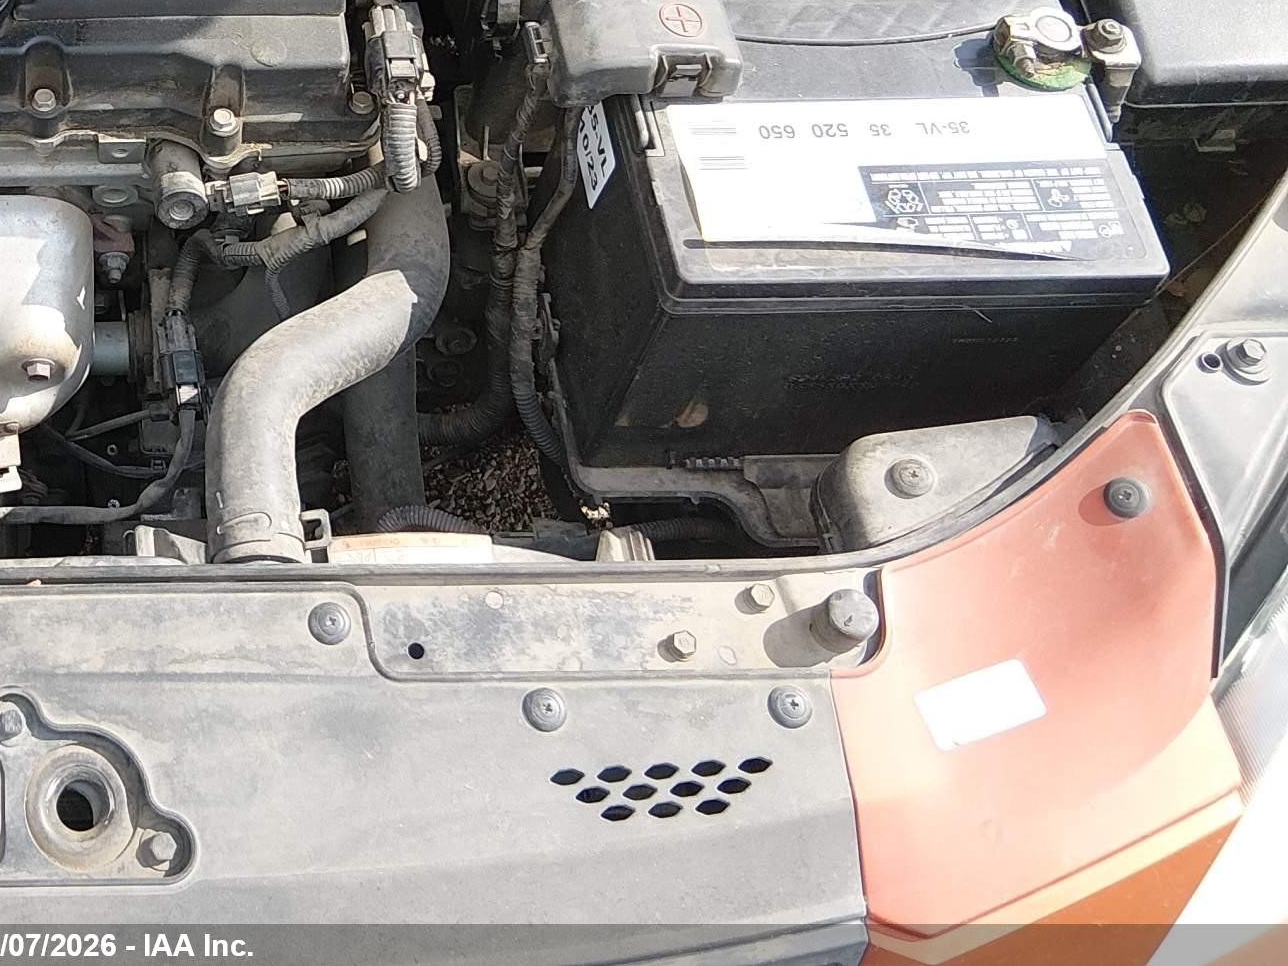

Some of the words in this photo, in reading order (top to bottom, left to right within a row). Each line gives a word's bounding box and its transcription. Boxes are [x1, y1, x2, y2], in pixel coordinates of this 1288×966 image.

[758, 124, 796, 140] 650
[811, 123, 849, 138] 520
[868, 123, 893, 137] 35
[915, 121, 971, 136] 35-VL
